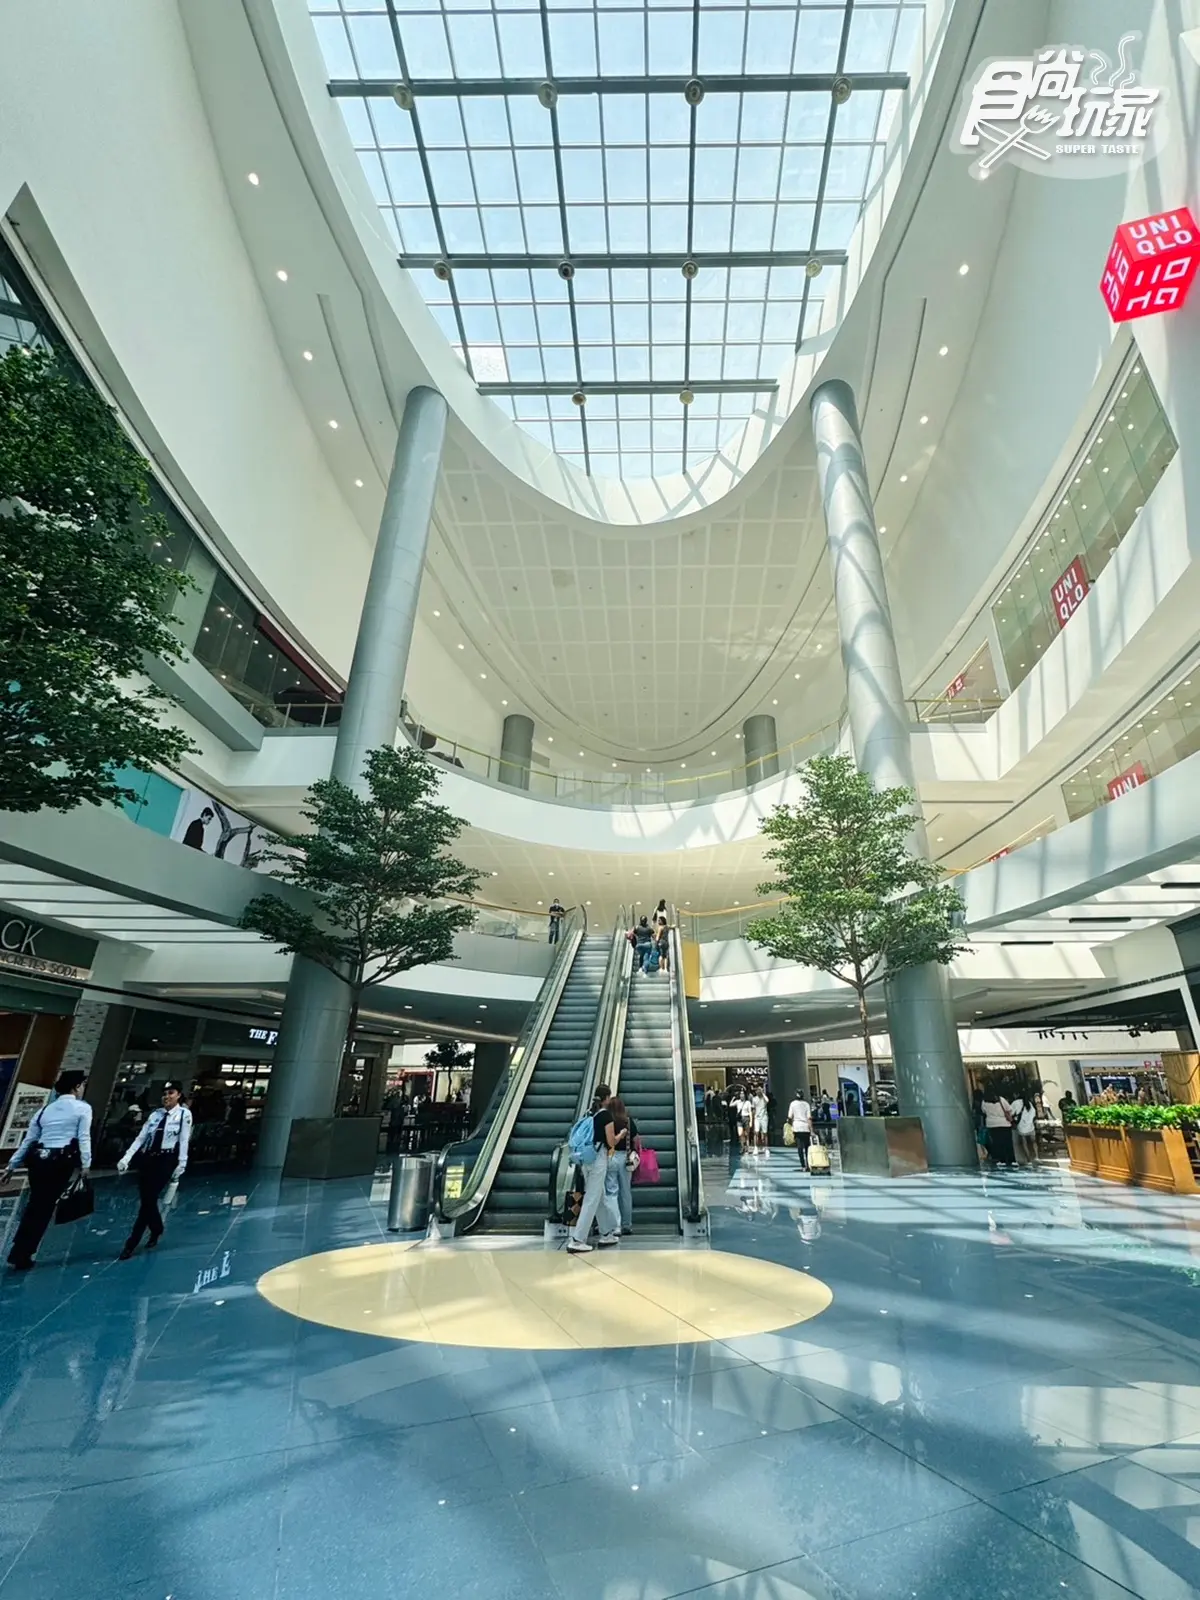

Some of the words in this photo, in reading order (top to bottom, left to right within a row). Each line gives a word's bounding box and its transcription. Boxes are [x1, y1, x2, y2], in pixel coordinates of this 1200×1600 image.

[1128, 214, 1182, 240] UNI
[1136, 230, 1193, 256] QLO
[1054, 567, 1078, 603] UNI
[1060, 583, 1084, 620] QLO
[1112, 772, 1139, 799] UNI
[1, 919, 44, 955] CK
[48, 963, 78, 978] SODA
[249, 1028, 268, 1040] THE
